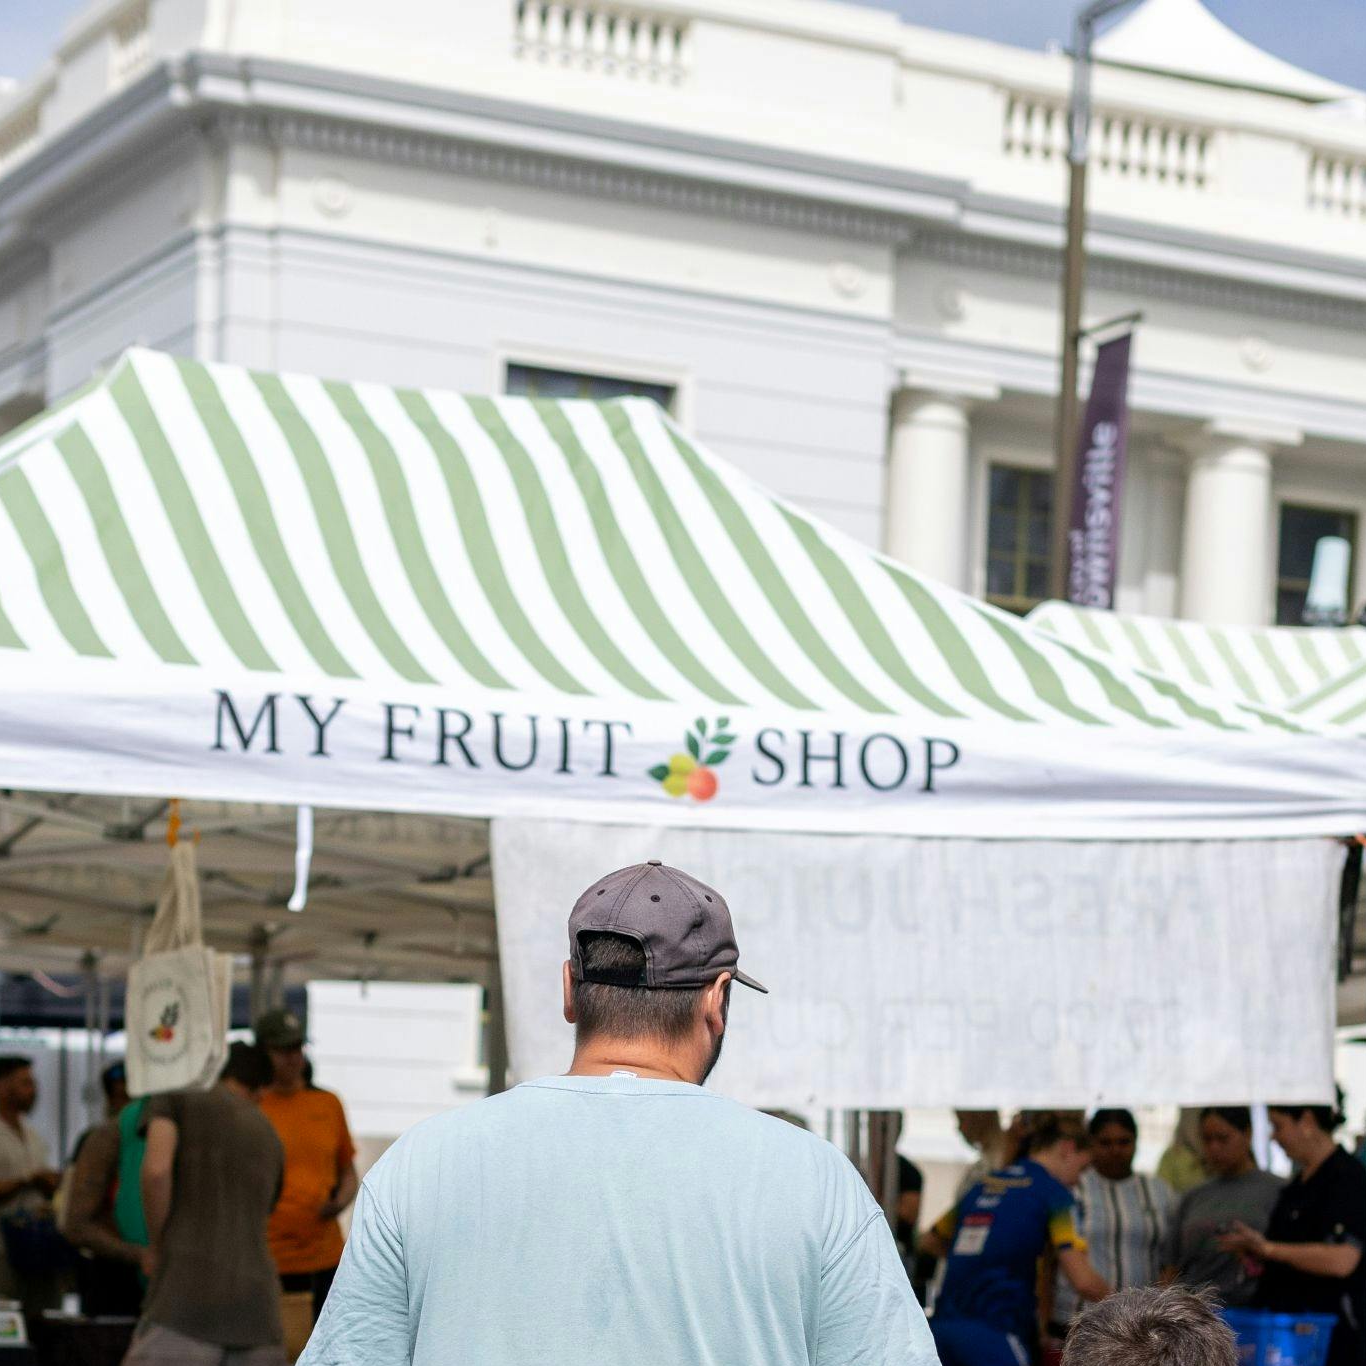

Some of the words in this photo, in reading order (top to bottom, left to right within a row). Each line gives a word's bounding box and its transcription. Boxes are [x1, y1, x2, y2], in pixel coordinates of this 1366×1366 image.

[208, 688, 348, 758] MY
[380, 702, 633, 778] FRUIT
[751, 727, 961, 794] SHOP
